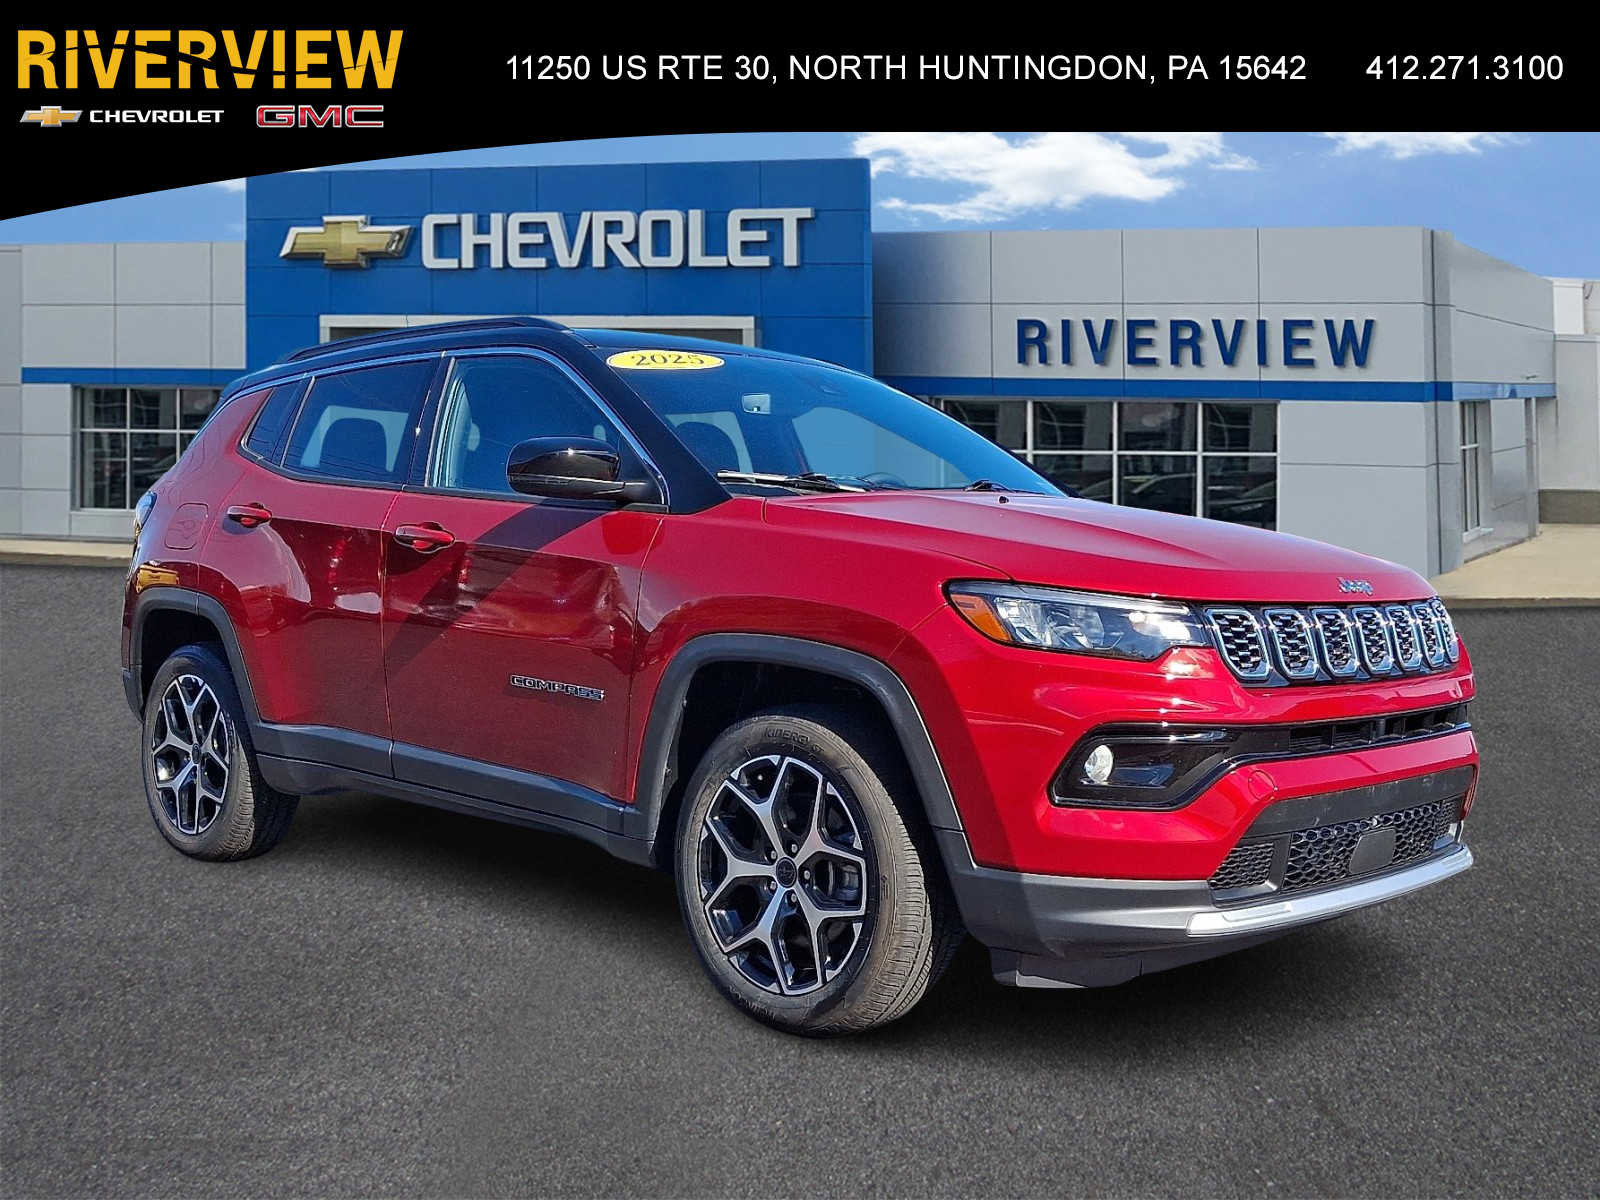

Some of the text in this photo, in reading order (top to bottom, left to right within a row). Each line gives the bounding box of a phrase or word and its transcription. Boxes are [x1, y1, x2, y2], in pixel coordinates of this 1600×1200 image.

[421, 207, 814, 270] CHEVROLET
[631, 353, 705, 367] 2025
[1016, 318, 1375, 368] RIVERVIEW
[509, 674, 605, 701] COMPASS
